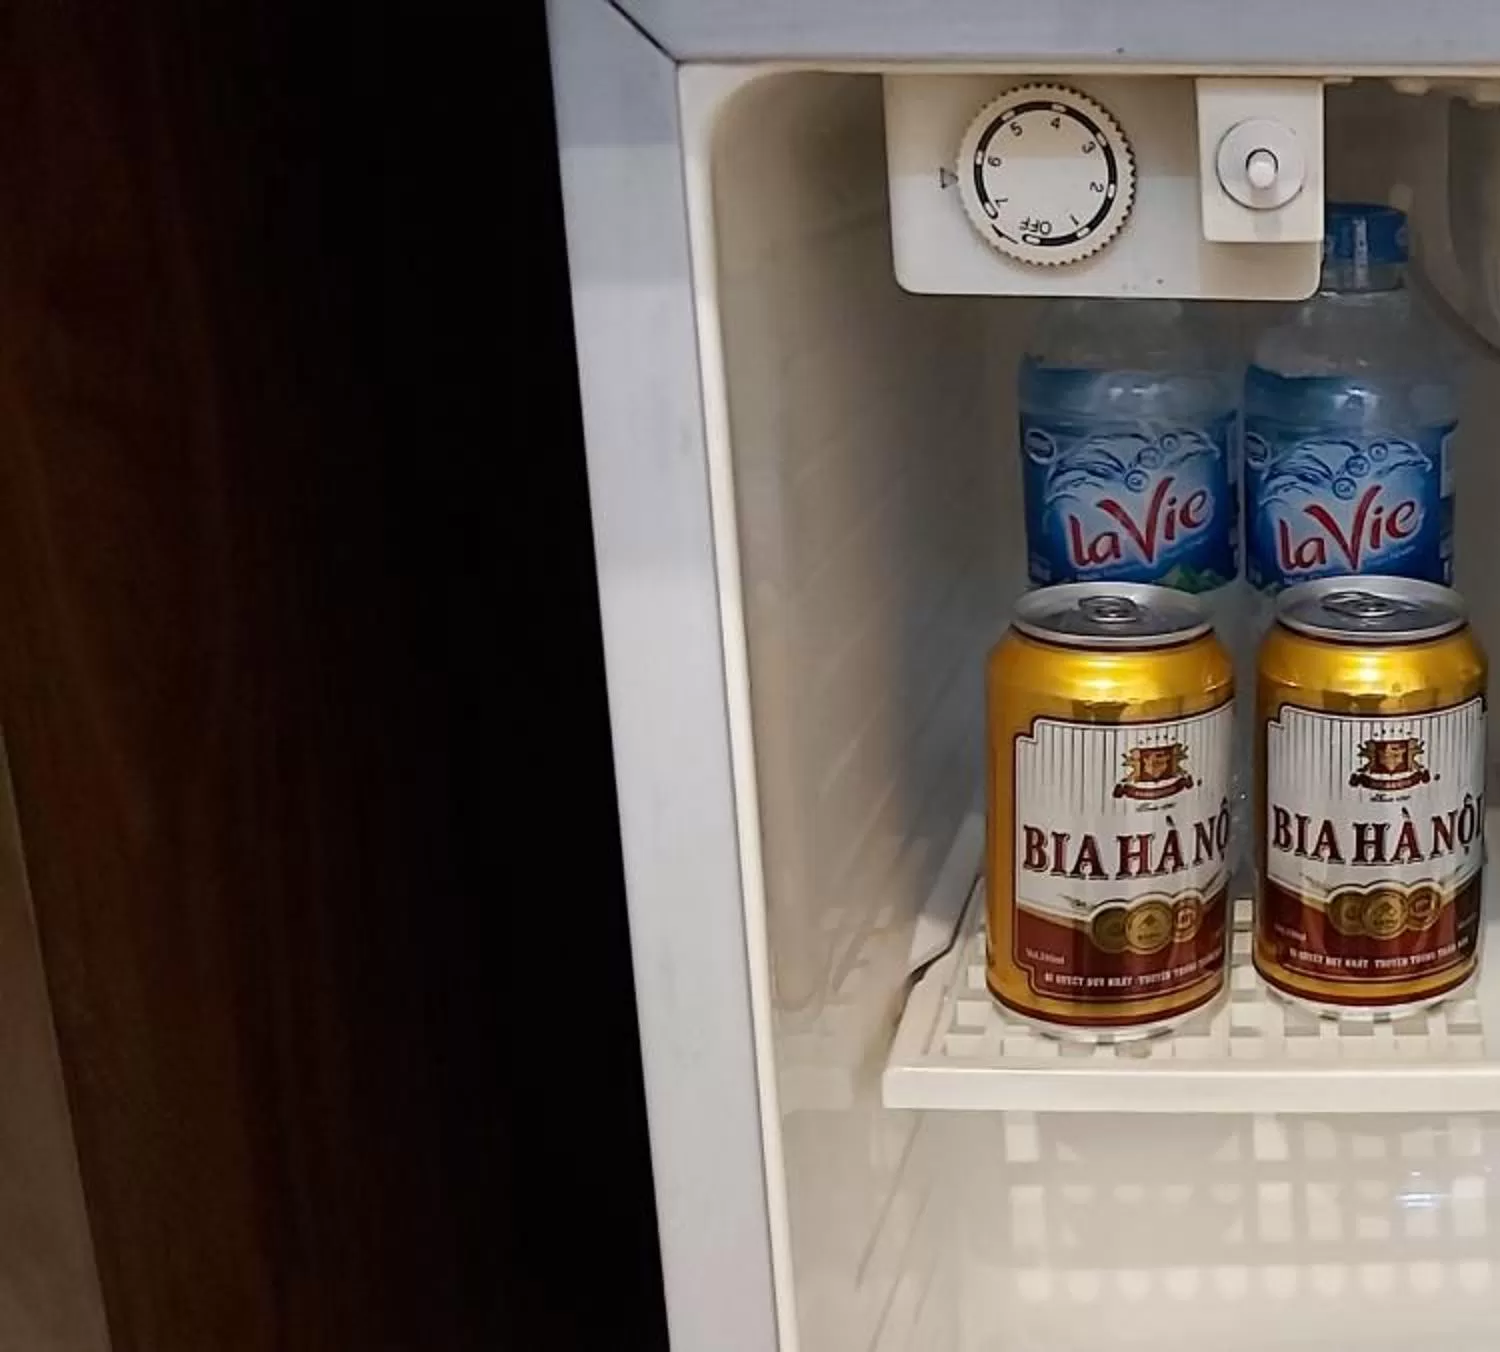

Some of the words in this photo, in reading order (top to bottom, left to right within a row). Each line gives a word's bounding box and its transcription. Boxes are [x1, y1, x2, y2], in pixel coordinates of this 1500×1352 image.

[1010, 121, 1023, 137] 5
[1051, 117, 1061, 130] 4
[1082, 141, 1096, 154] 3
[988, 156, 1002, 167] 6
[1090, 181, 1104, 193] 2
[1020, 216, 1052, 236] OFF
[1023, 824, 1109, 881] BIA
[1115, 815, 1188, 881] HÀ
[1192, 796, 1230, 867] NỘ
[1273, 804, 1346, 865] BIA
[1351, 807, 1425, 866] HÀ
